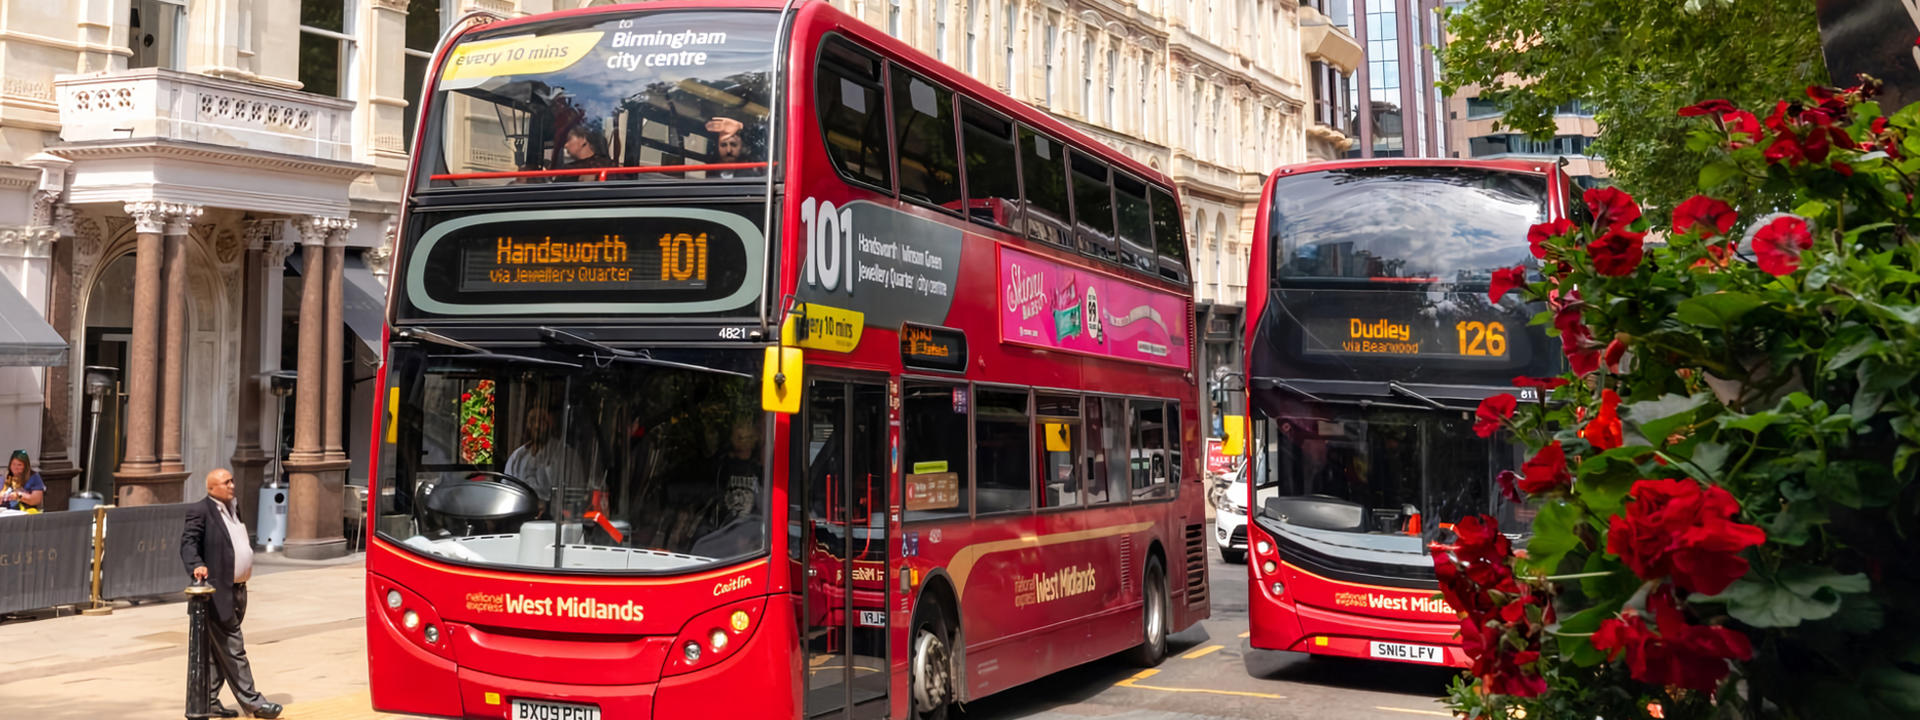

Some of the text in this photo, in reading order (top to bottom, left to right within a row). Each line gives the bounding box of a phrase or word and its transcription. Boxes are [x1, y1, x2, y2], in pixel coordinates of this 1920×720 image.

[619, 20, 633, 29] to
[612, 30, 726, 49] Birmingham
[456, 45, 569, 66] every 10 mins
[607, 51, 707, 71] city centre
[497, 236, 627, 265] Handsworth
[801, 196, 853, 293] 101
[858, 233, 898, 259] Handsworth
[924, 250, 943, 271] Green
[659, 232, 707, 281] 101
[489, 266, 633, 283] via Jewellery Quarter
[858, 260, 889, 288] Jewellery
[890, 267, 914, 289] Quarter
[718, 327, 746, 339] 4821
[824, 315, 835, 336] 10
[835, 318, 853, 339] mins
[1350, 318, 1410, 341] Dudley
[1362, 340, 1420, 355] Bearwood
[1455, 320, 1506, 356] 126
[713, 575, 752, 597] Caitlin
[1034, 562, 1097, 605] West Midlands
[465, 592, 504, 604] national
[465, 601, 504, 613] express
[505, 593, 645, 622] West Midlands
[1368, 593, 1457, 614] West Midla
[1378, 643, 1435, 660] SN15 LFV
[519, 703, 560, 720] BX09
